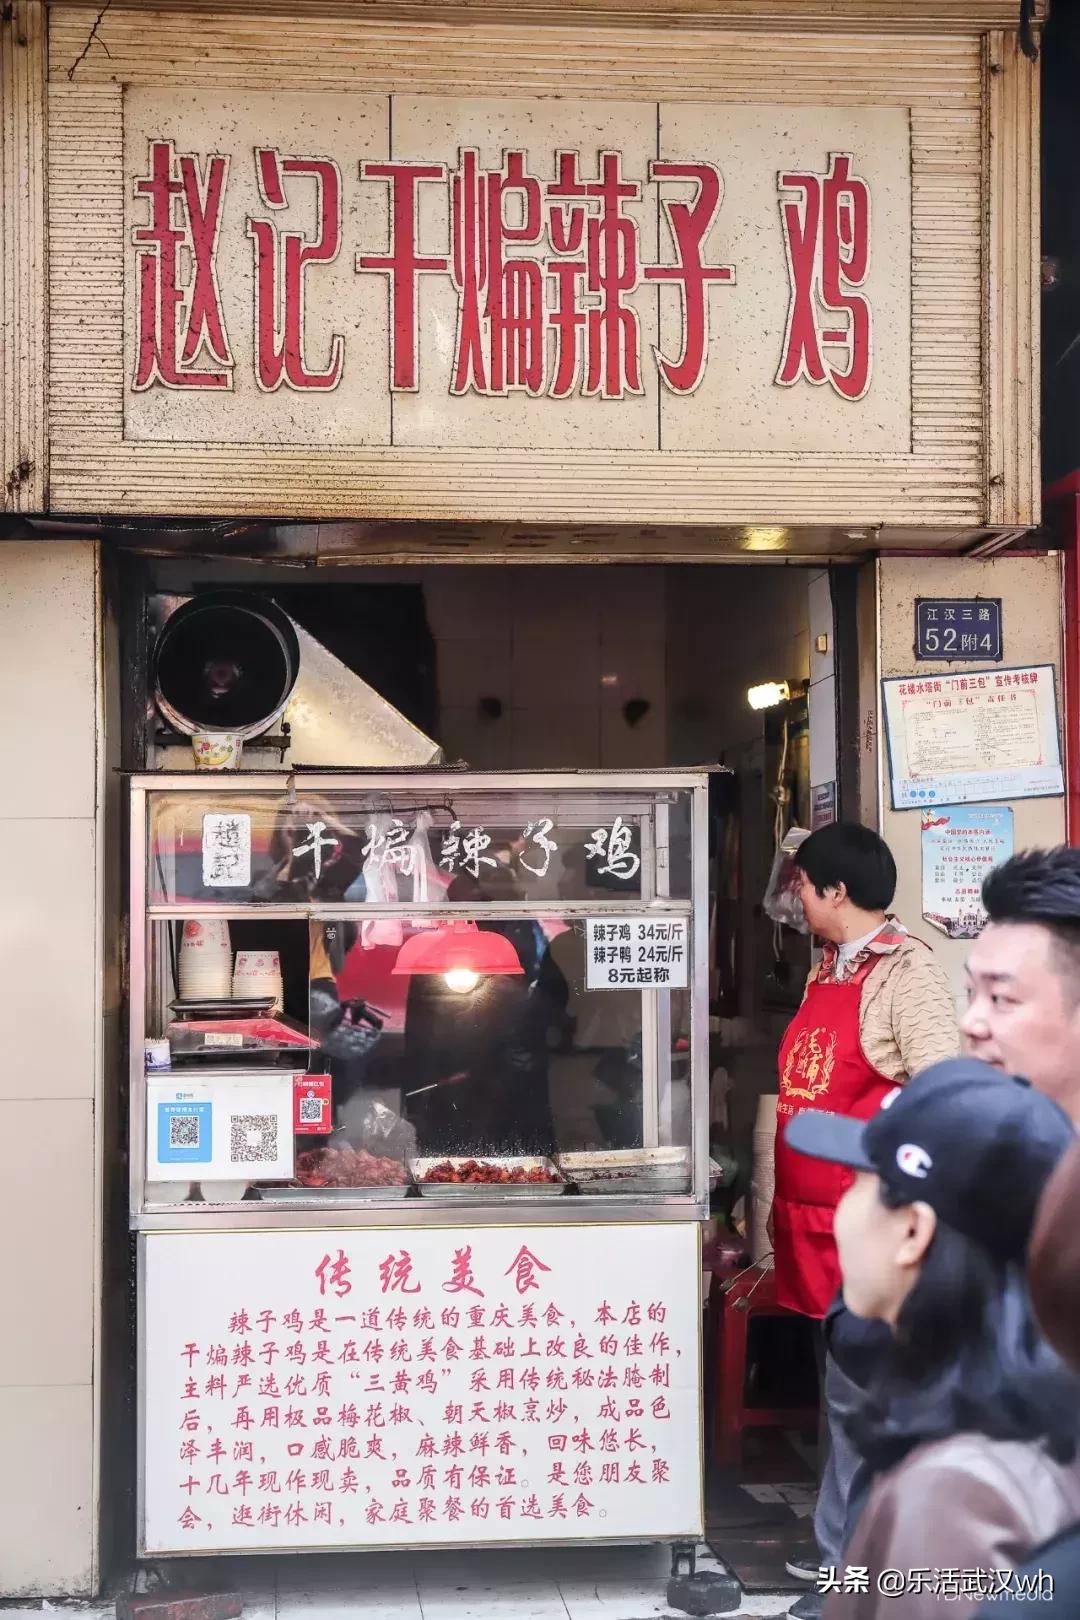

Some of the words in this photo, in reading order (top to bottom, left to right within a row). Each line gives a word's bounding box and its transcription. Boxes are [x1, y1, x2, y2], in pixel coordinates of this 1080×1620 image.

[133, 139, 873, 400] 赵记干煸辣子鸡
[927, 608, 991, 621] 江汉三路
[925, 628, 992, 651] 52附4
[593, 924, 631, 941] 辣子鸡
[638, 924, 684, 941] 34元/斤
[593, 946, 632, 964] 辣子鸭
[638, 946, 684, 963] 24元/斤
[608, 967, 670, 983] 8元起称
[313, 1244, 552, 1298] 传统美食
